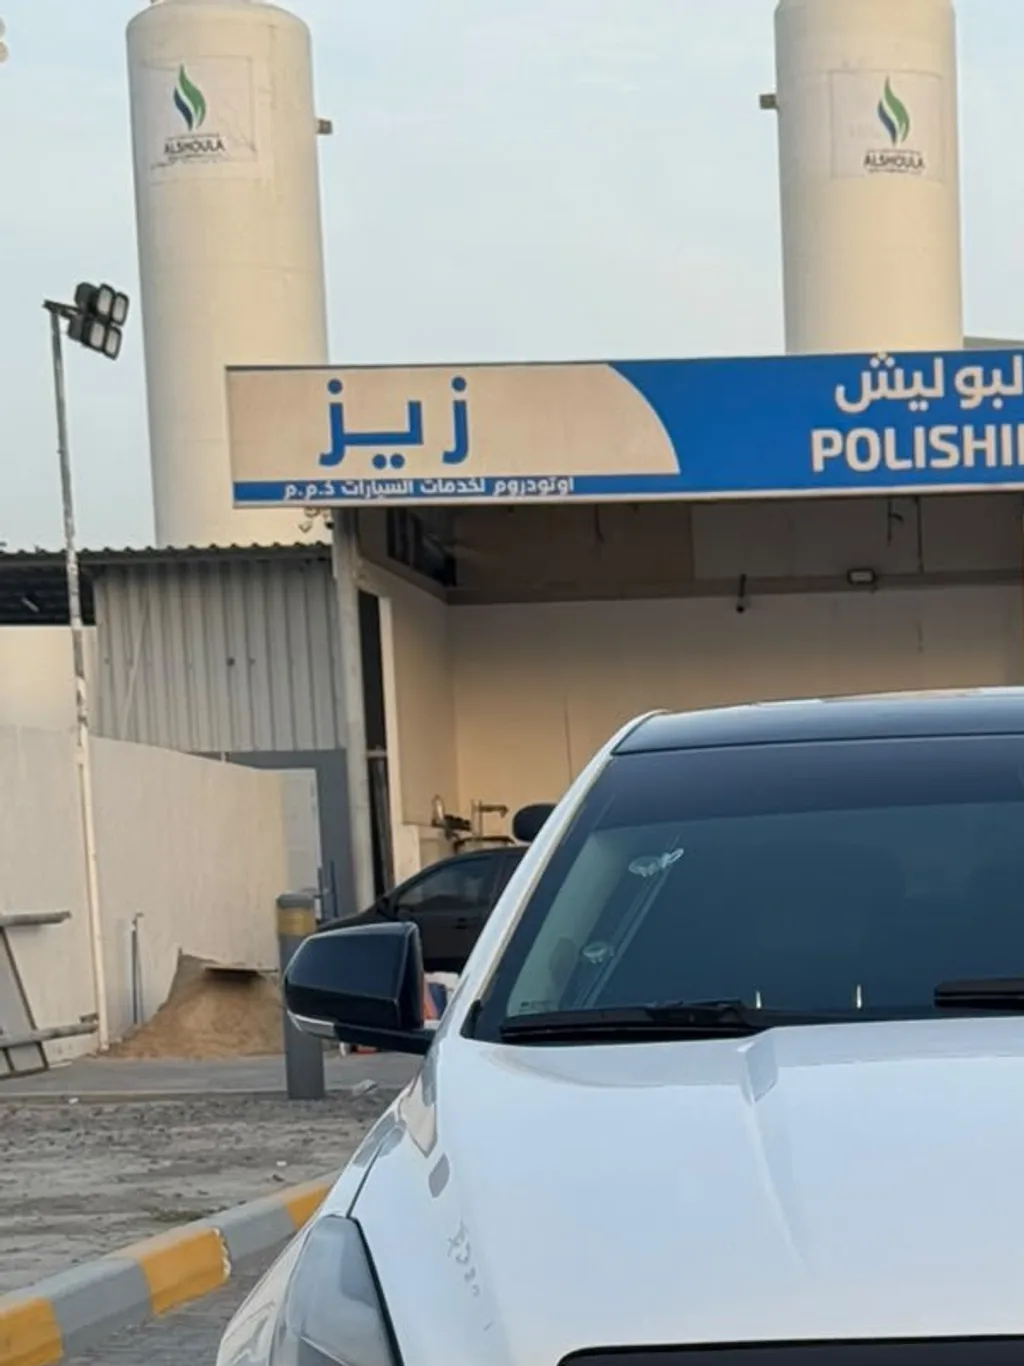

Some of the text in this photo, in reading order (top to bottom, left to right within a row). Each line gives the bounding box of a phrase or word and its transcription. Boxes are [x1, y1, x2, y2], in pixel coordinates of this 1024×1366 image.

[864, 154, 926, 169] ALSHOULA
[341, 479, 414, 500] السيارات
[420, 477, 486, 494] لخدمات
